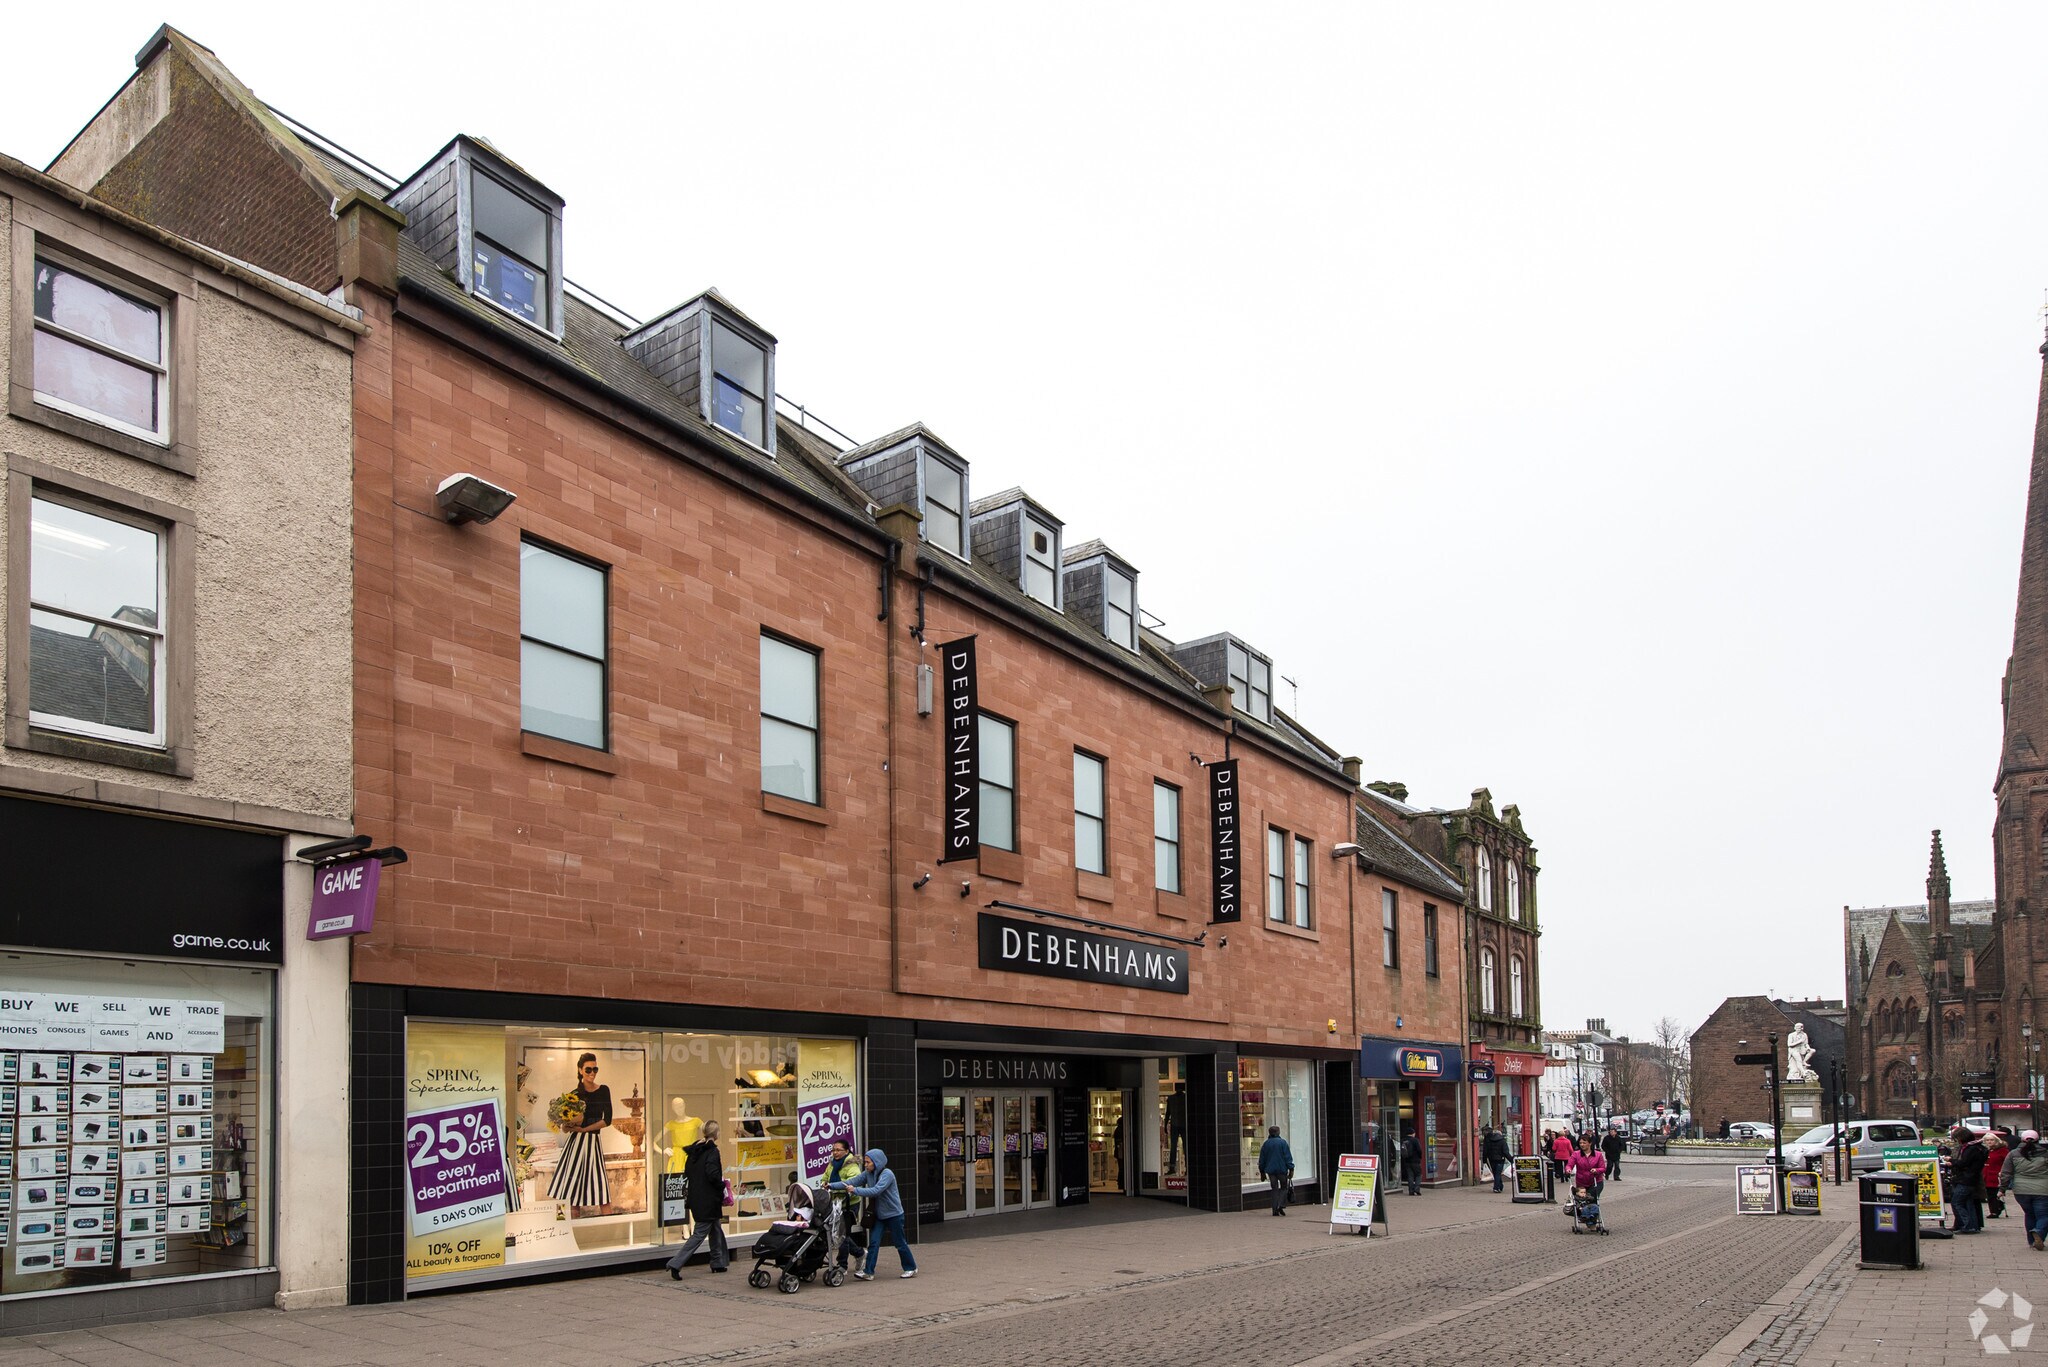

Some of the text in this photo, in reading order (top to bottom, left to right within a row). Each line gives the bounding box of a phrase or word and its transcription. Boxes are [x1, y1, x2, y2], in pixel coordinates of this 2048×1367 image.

[951, 651, 970, 849] DEBENHAMS
[1216, 769, 1234, 914] DEBENHAMS
[322, 866, 364, 895] GAME
[322, 918, 346, 930] game.co.uk
[172, 933, 271, 952] game.co.uk
[1001, 926, 1177, 983] DEBENHAMS
[1, 999, 219, 1017] BUY WE SELL WE TRADE
[0, 1026, 38, 1035] HONES
[47, 1026, 86, 1034] CONSOLES
[100, 1029, 129, 1037] GAMES
[146, 1031, 174, 1041] AND
[943, 1058, 1067, 1080] DEBENHAMS
[1426, 1056, 1438, 1070] HILL
[1503, 1056, 1523, 1073] Shelter
[427, 1069, 480, 1081] SPRING
[812, 1070, 841, 1080] SPRING
[409, 1079, 499, 1097] Spectacular
[801, 1103, 850, 1145] 25%
[407, 1112, 493, 1169] 25%
[818, 1143, 834, 1155] eve
[437, 1162, 476, 1181] every
[417, 1169, 501, 1201] department
[433, 1202, 494, 1225] 5 DAYS ONLY
[428, 1239, 481, 1256] 10% OFF
[406, 1251, 501, 1268] ALL beauty & fragrance
